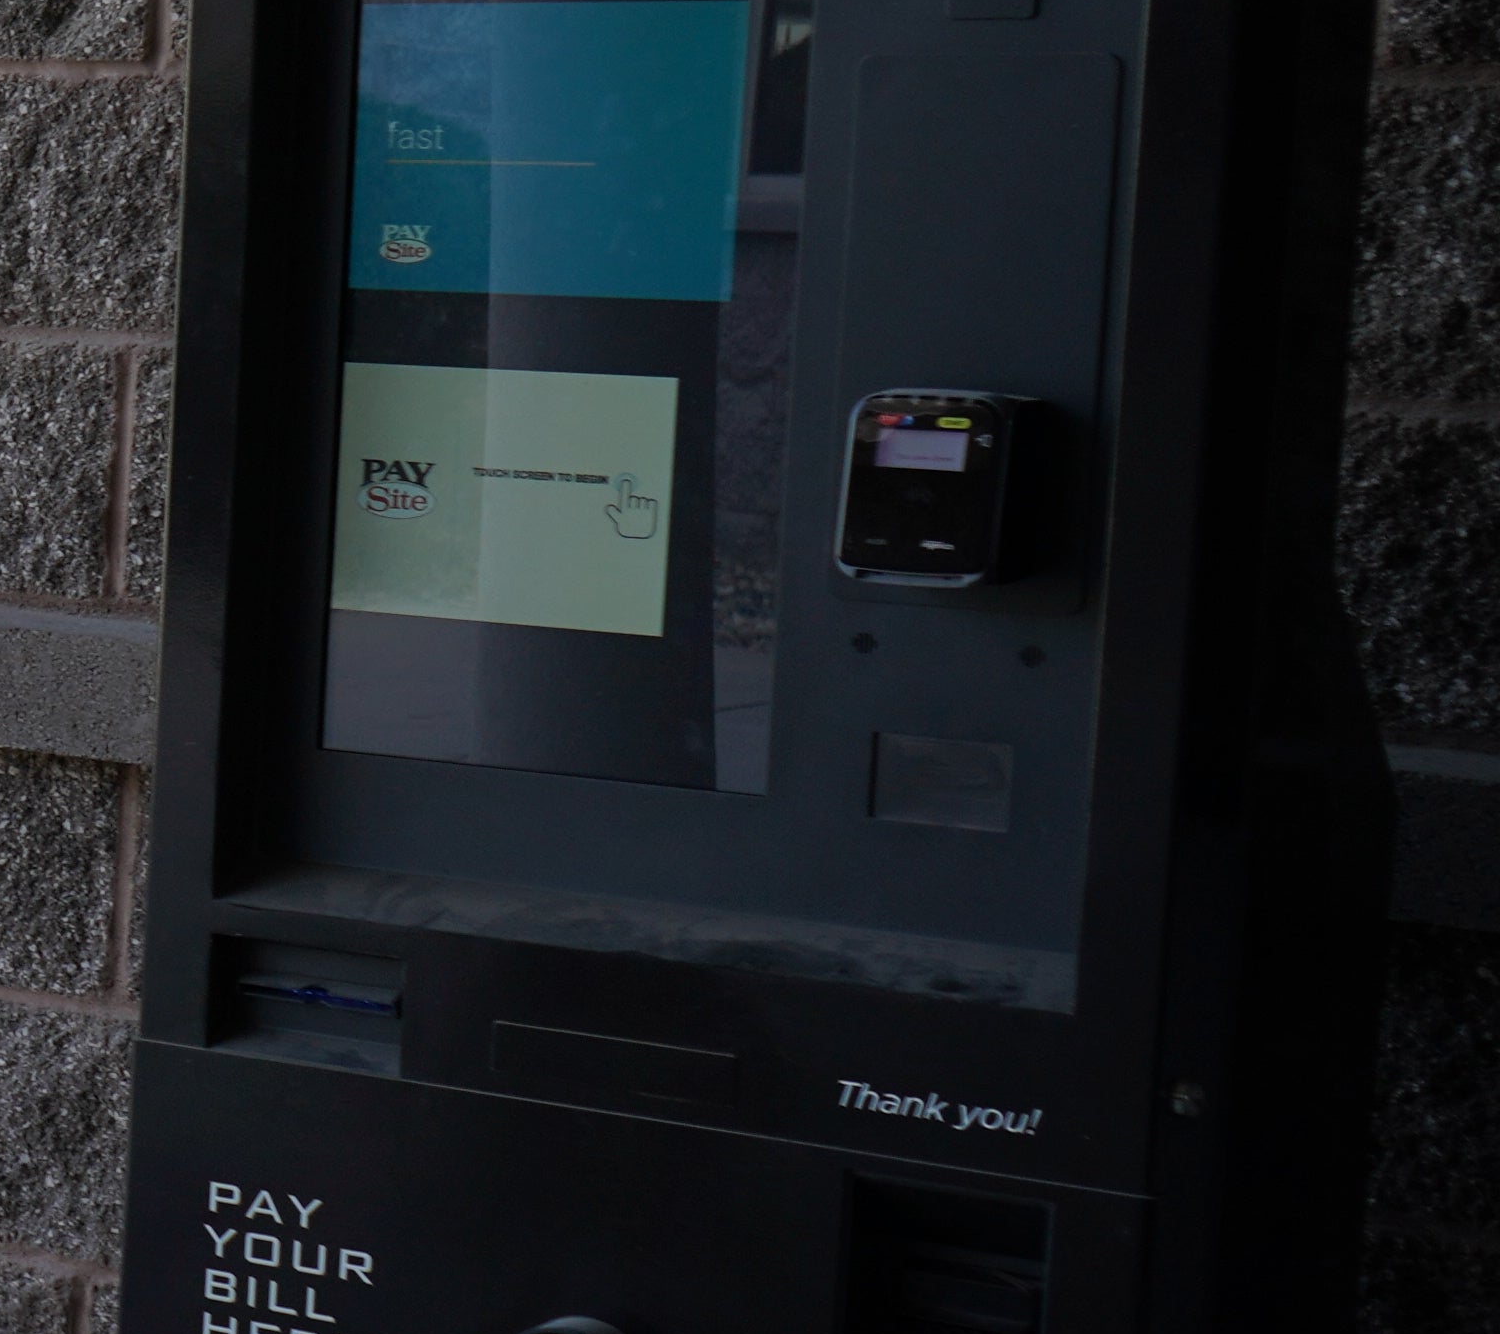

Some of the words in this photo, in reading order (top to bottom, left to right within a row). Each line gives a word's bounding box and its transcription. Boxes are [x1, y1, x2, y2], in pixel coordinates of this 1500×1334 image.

[387, 120, 445, 151] fast
[380, 223, 432, 242] PAY
[383, 241, 426, 261] Site
[360, 458, 436, 488] PAY
[366, 485, 428, 513] Site
[837, 1079, 950, 1124] Thank
[951, 1103, 1043, 1137] you!
[208, 1180, 325, 1230] PAY
[203, 1222, 375, 1287] YOUR
[203, 1267, 338, 1325] BILL
